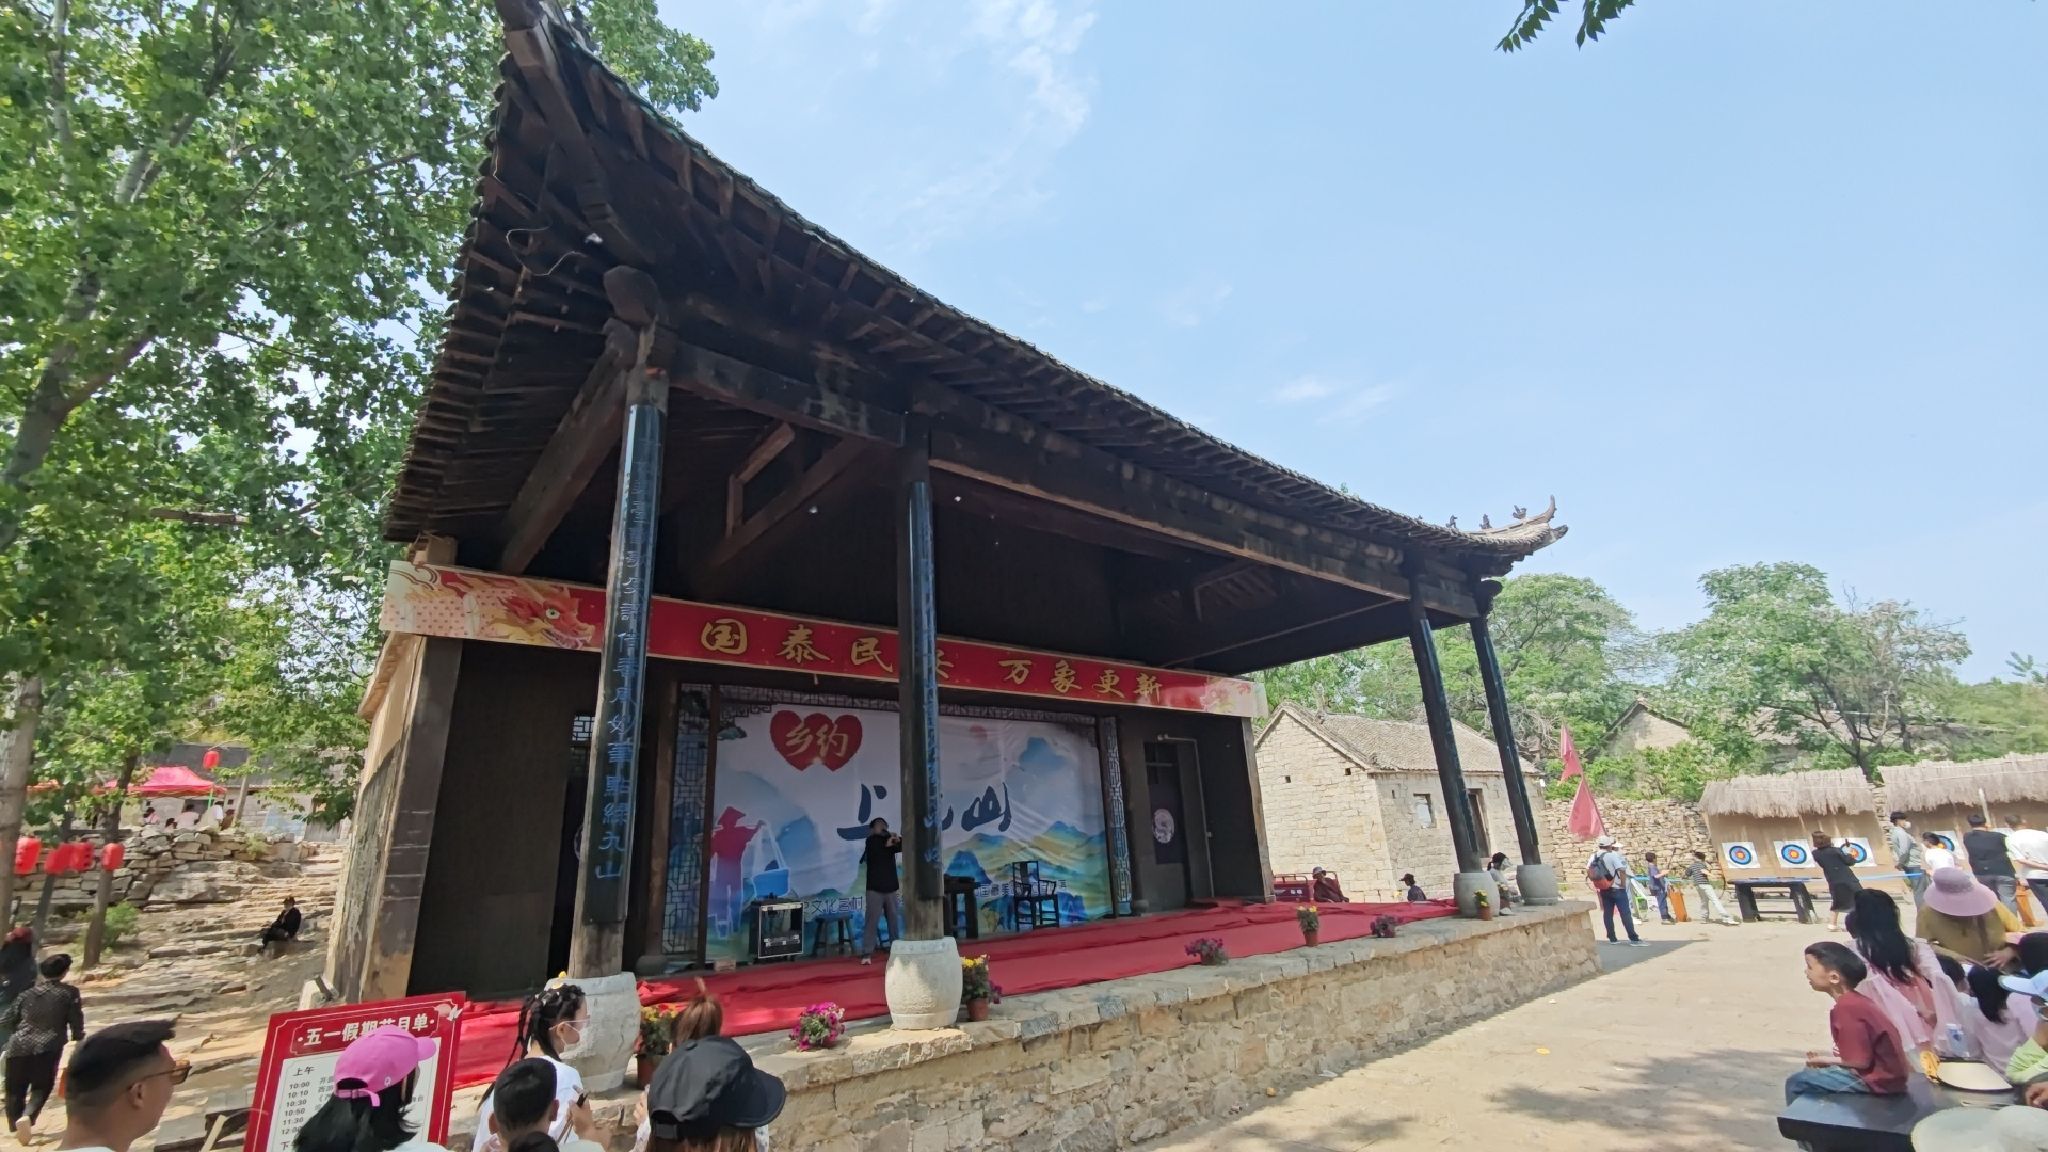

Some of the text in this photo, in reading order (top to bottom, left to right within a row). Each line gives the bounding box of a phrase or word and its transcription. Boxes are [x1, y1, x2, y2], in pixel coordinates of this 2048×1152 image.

[999, 657, 1163, 701] 万象更新
[785, 721, 849, 758] 乡约
[837, 782, 1012, 842] 上山
[293, 1066, 316, 1077] 上午
